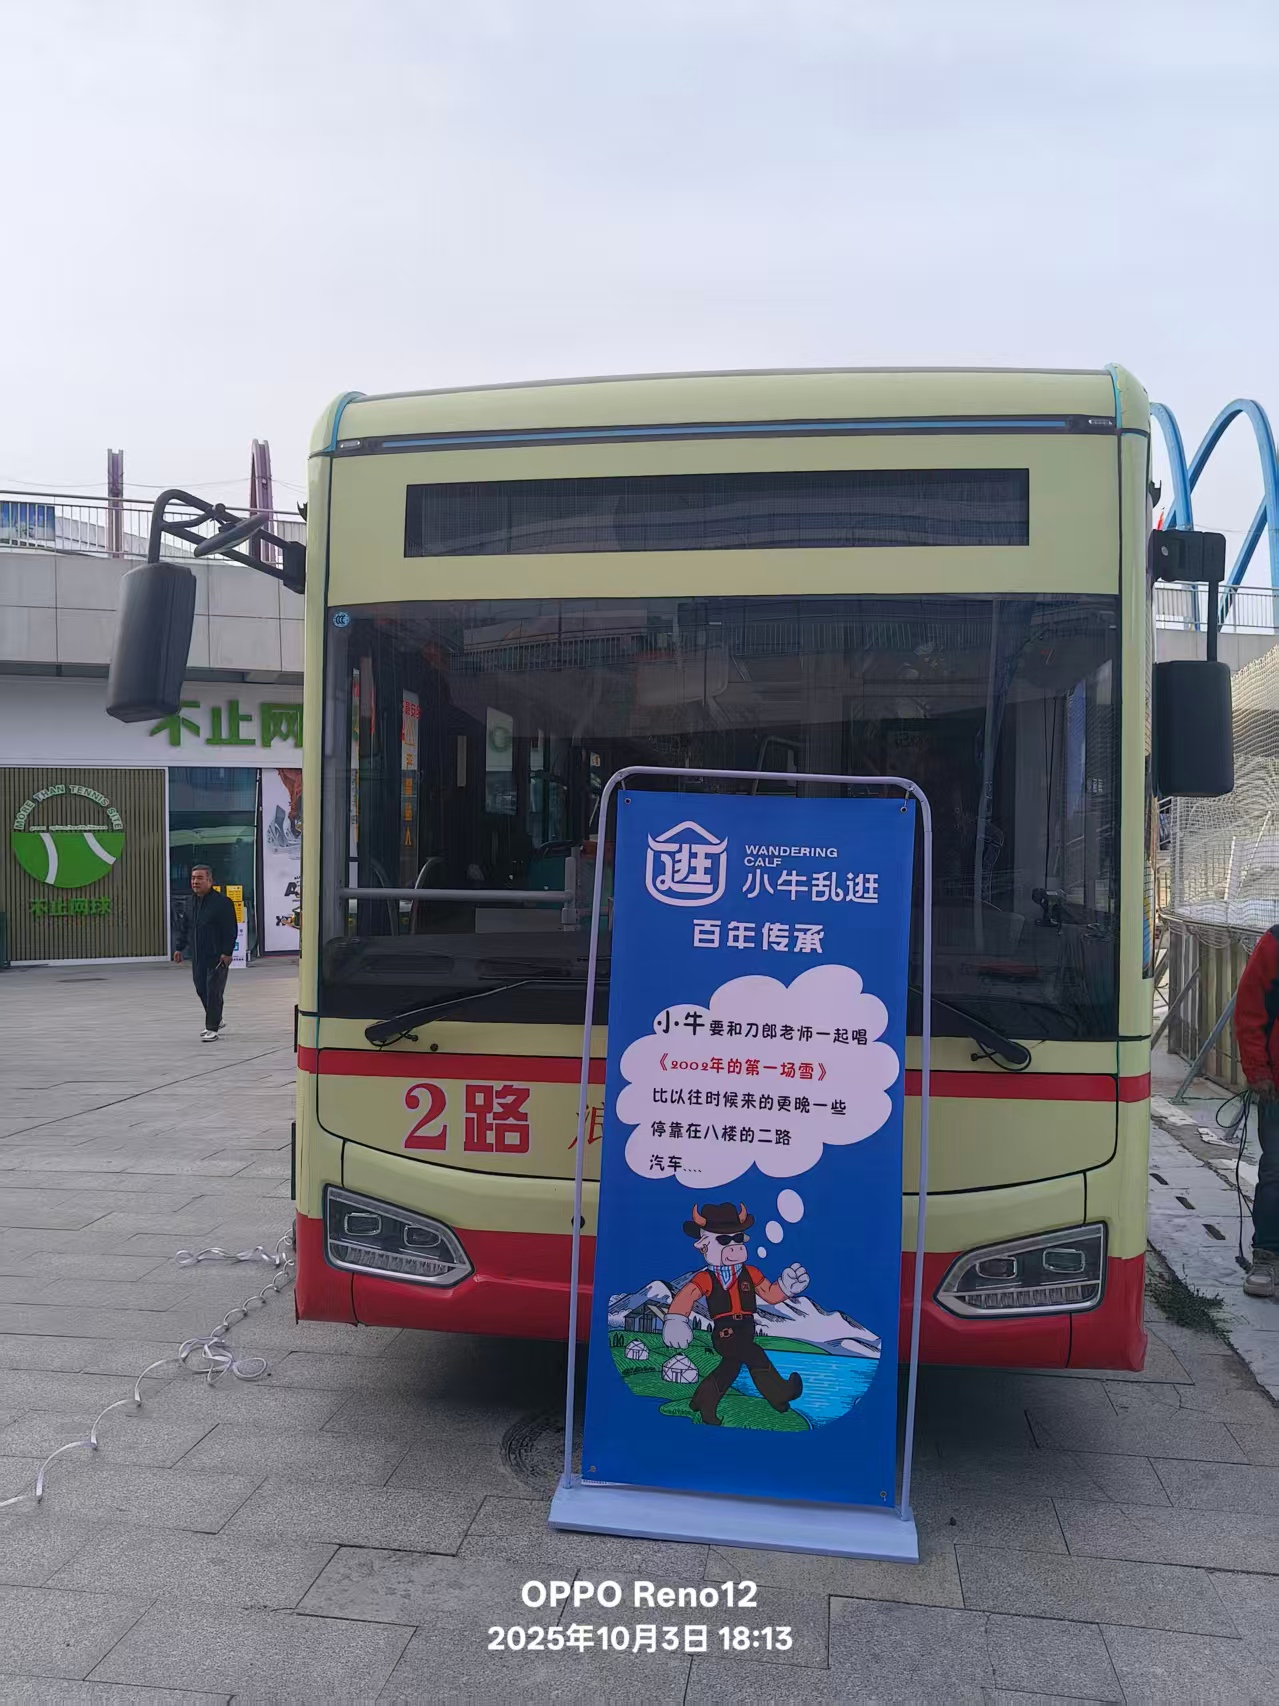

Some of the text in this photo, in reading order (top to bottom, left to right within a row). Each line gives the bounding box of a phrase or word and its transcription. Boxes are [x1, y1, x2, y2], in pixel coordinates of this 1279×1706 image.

[14, 784, 124, 830] MORE THAN TENNIS SITE
[744, 857, 782, 867] CALF
[745, 844, 838, 858] WANDERING
[742, 869, 879, 903] 小牛乱逛
[693, 919, 825, 953] 百年传承
[652, 1087, 847, 1116] 比以往时候来的更晚一些
[650, 1120, 792, 1146] 停靠在八楼的二路
